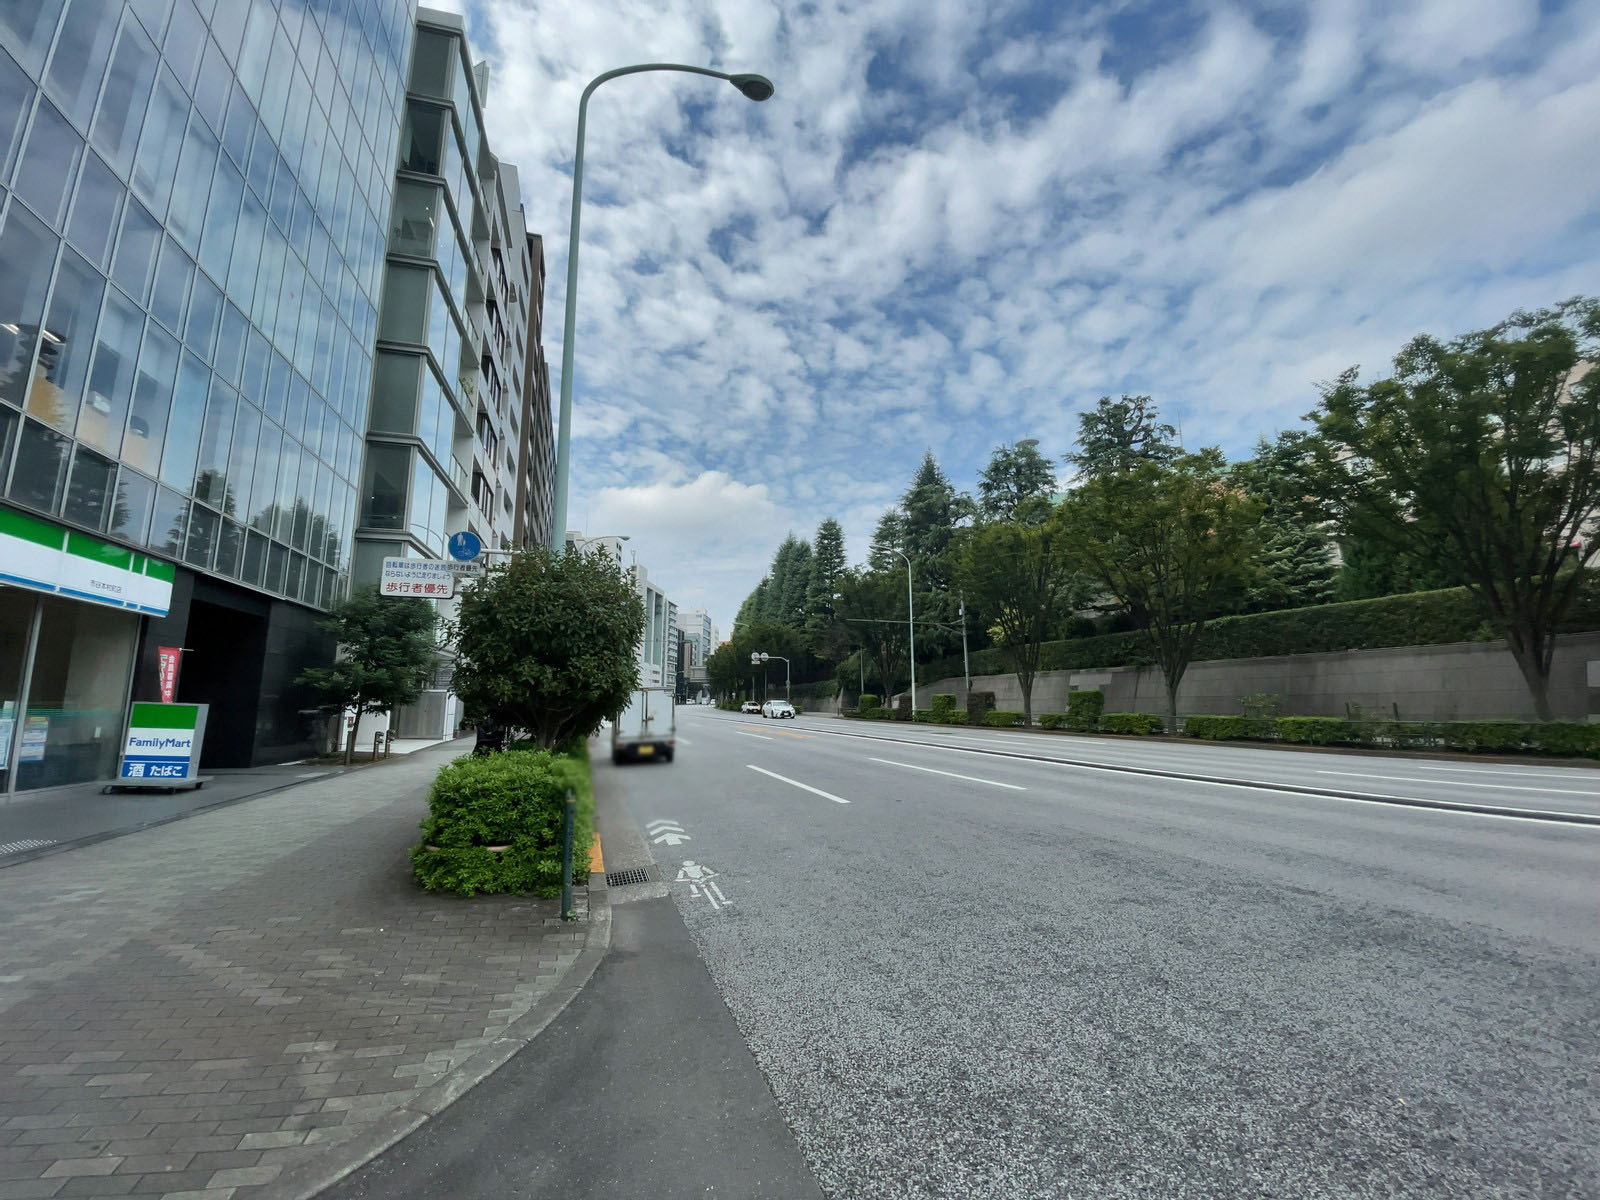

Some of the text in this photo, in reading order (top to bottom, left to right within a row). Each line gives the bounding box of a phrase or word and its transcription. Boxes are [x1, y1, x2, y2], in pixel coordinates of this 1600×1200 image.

[447, 563, 478, 572] 歩行者優先
[386, 582, 448, 594] 歩行者優先
[129, 737, 192, 749] FamilyMart
[128, 763, 183, 777] 酒 たばこ
